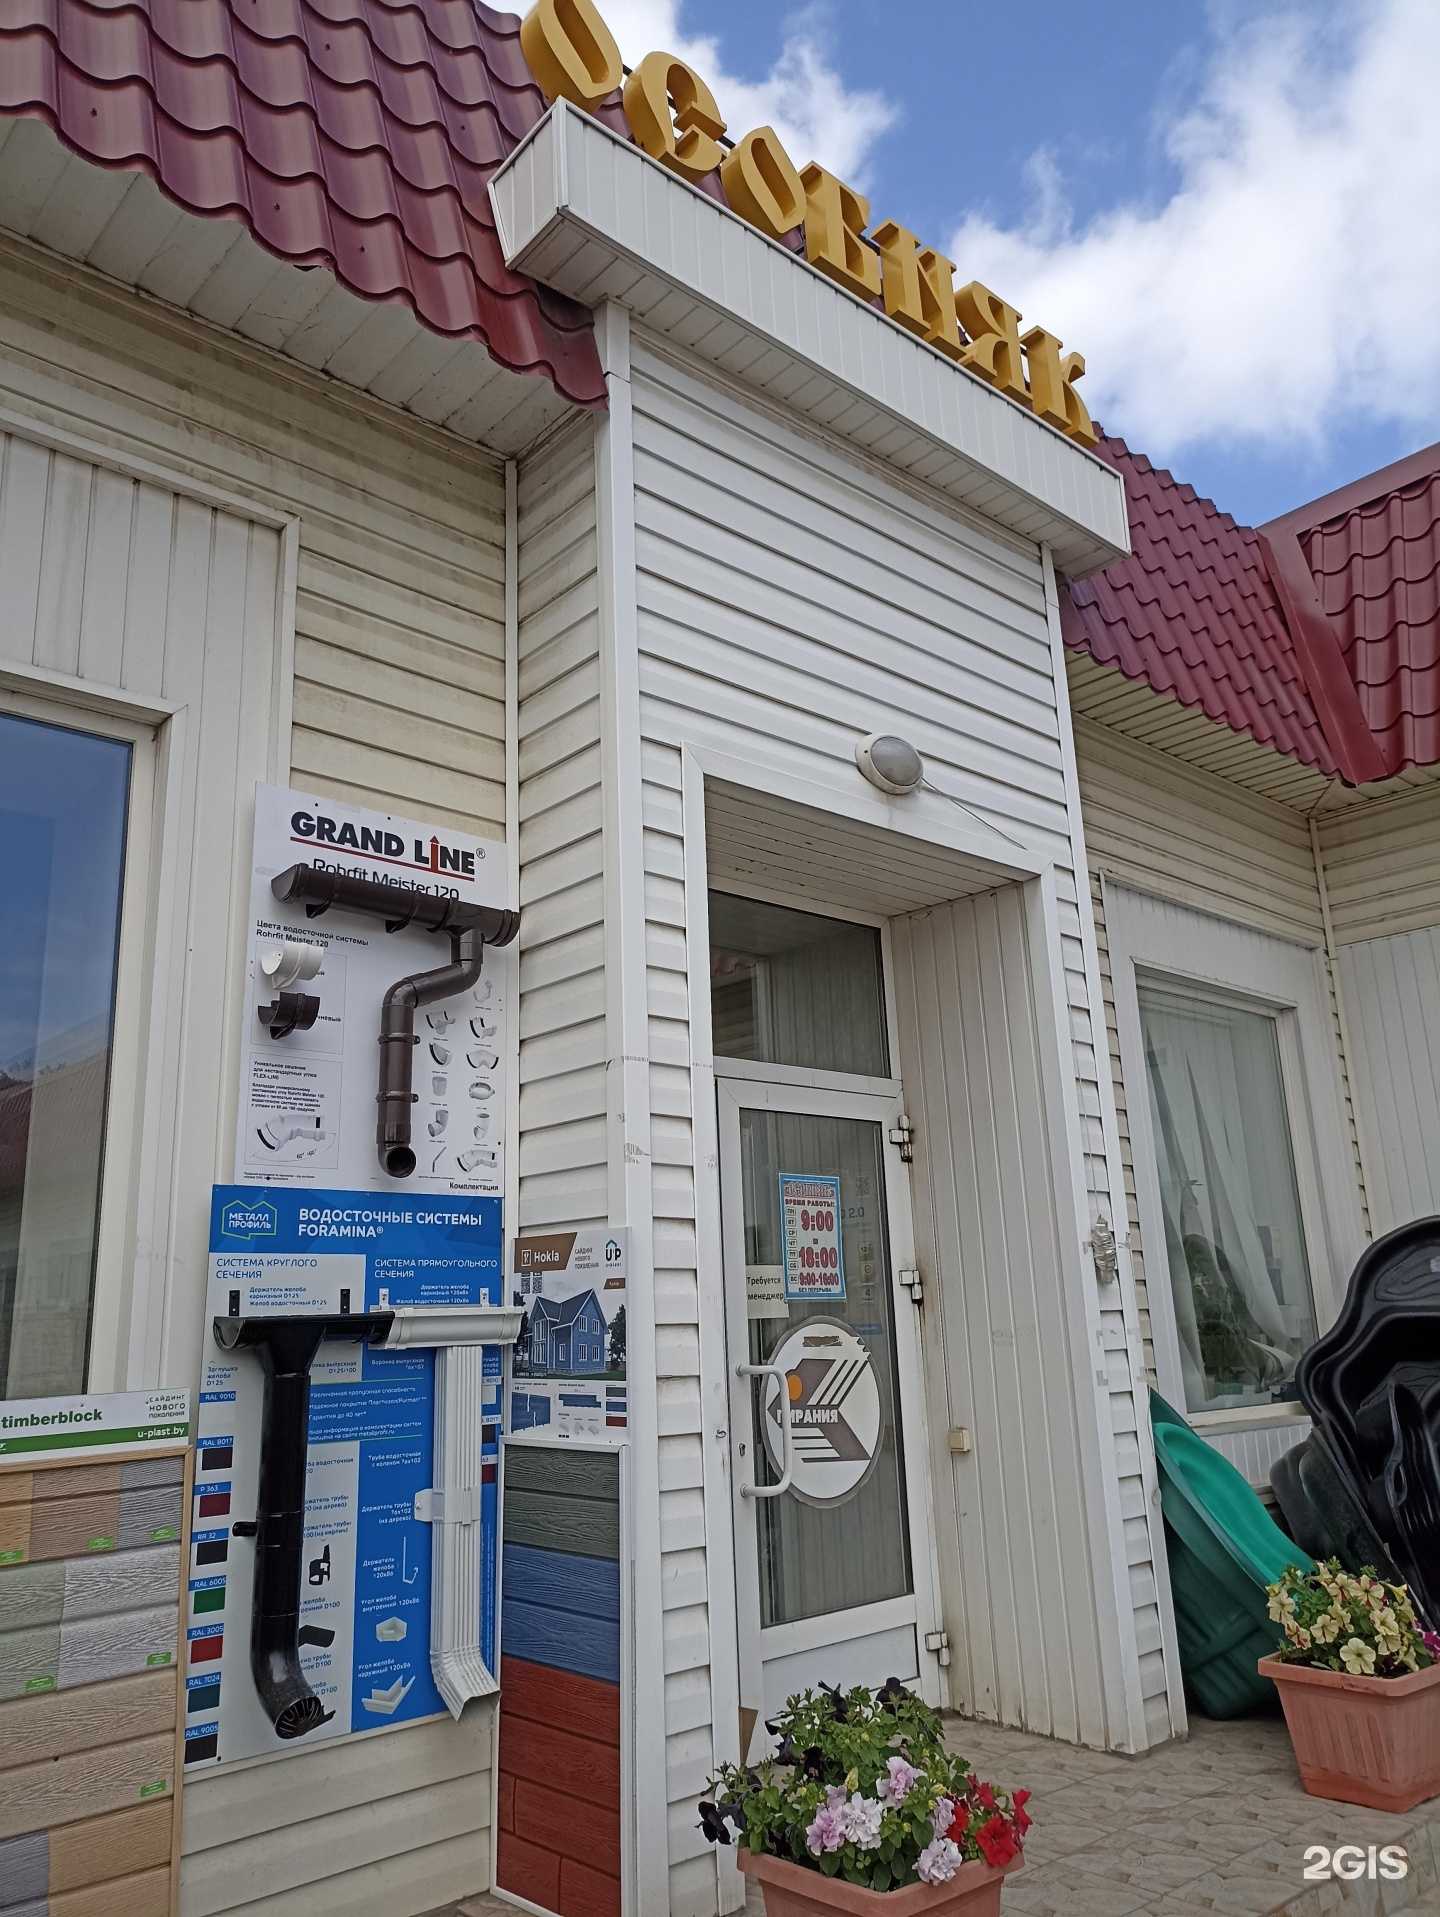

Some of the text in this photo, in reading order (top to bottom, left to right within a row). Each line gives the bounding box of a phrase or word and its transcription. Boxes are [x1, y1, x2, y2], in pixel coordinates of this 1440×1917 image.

[291, 811, 405, 857] GRAND
[372, 871, 432, 895] Meister
[434, 884, 460, 901] 120
[256, 920, 369, 946] Цвета водосточной системы
[256, 929, 284, 940] Rohrfit
[316, 938, 329, 948] 120
[449, 1182, 499, 1191] Комплектация
[229, 1212, 269, 1221] МЕТАЛЛ
[299, 1208, 482, 1226] ВОДОСТОЧНЫЕ СИСТЕМЫ
[801, 1209, 834, 1231] 9:00
[228, 1220, 272, 1229] ПРОФИЛЬ
[534, 1250, 560, 1263] Hokla
[799, 1246, 838, 1269] 18:00
[216, 1258, 318, 1268] СИСТЕМА КРУГЛОГО
[374, 1258, 498, 1268] СИСТЕМА ПРЯМОУГОЛЬНОГО
[216, 1270, 262, 1279] СЕЧЕНИЯ
[374, 1269, 414, 1278] СЕЧЕНИЯ
[746, 1276, 781, 1286] Требуется
[748, 1293, 784, 1301] менеджер
[219, 1392, 235, 1400] 9010
[149, 1403, 186, 1411] НОВОГО
[1, 1408, 103, 1429] timberblock
[137, 1426, 184, 1439] u-plast.by
[206, 1484, 218, 1492] 363
[194, 1580, 208, 1588] RAL
[191, 1628, 206, 1637] RAL
[188, 1678, 202, 1686] RAL
[185, 1729, 200, 1738] RAL
